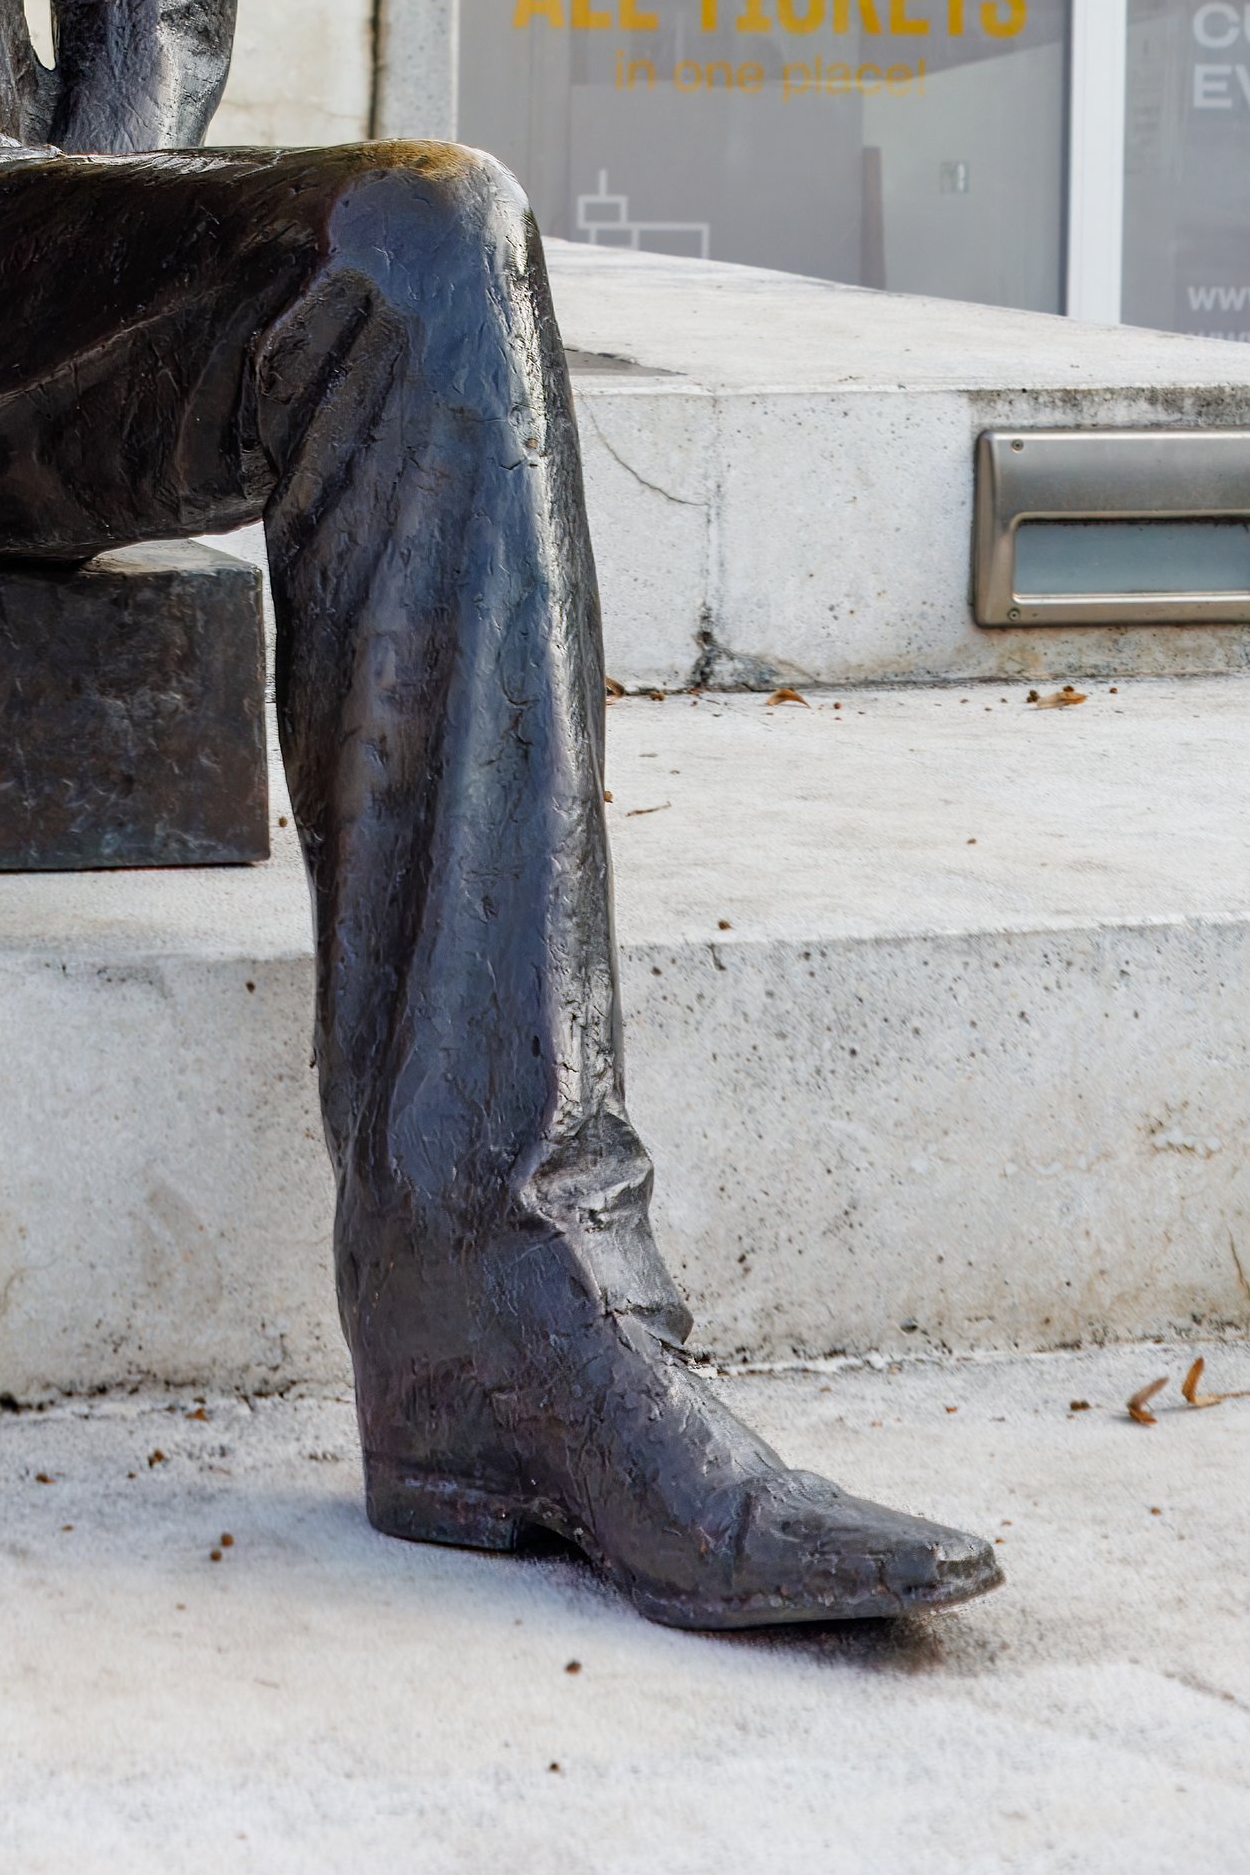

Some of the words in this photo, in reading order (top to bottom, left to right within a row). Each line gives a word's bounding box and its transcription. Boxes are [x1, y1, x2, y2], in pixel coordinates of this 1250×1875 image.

[615, 49, 655, 93] in
[673, 59, 765, 94] one
[782, 53, 926, 105] place!
